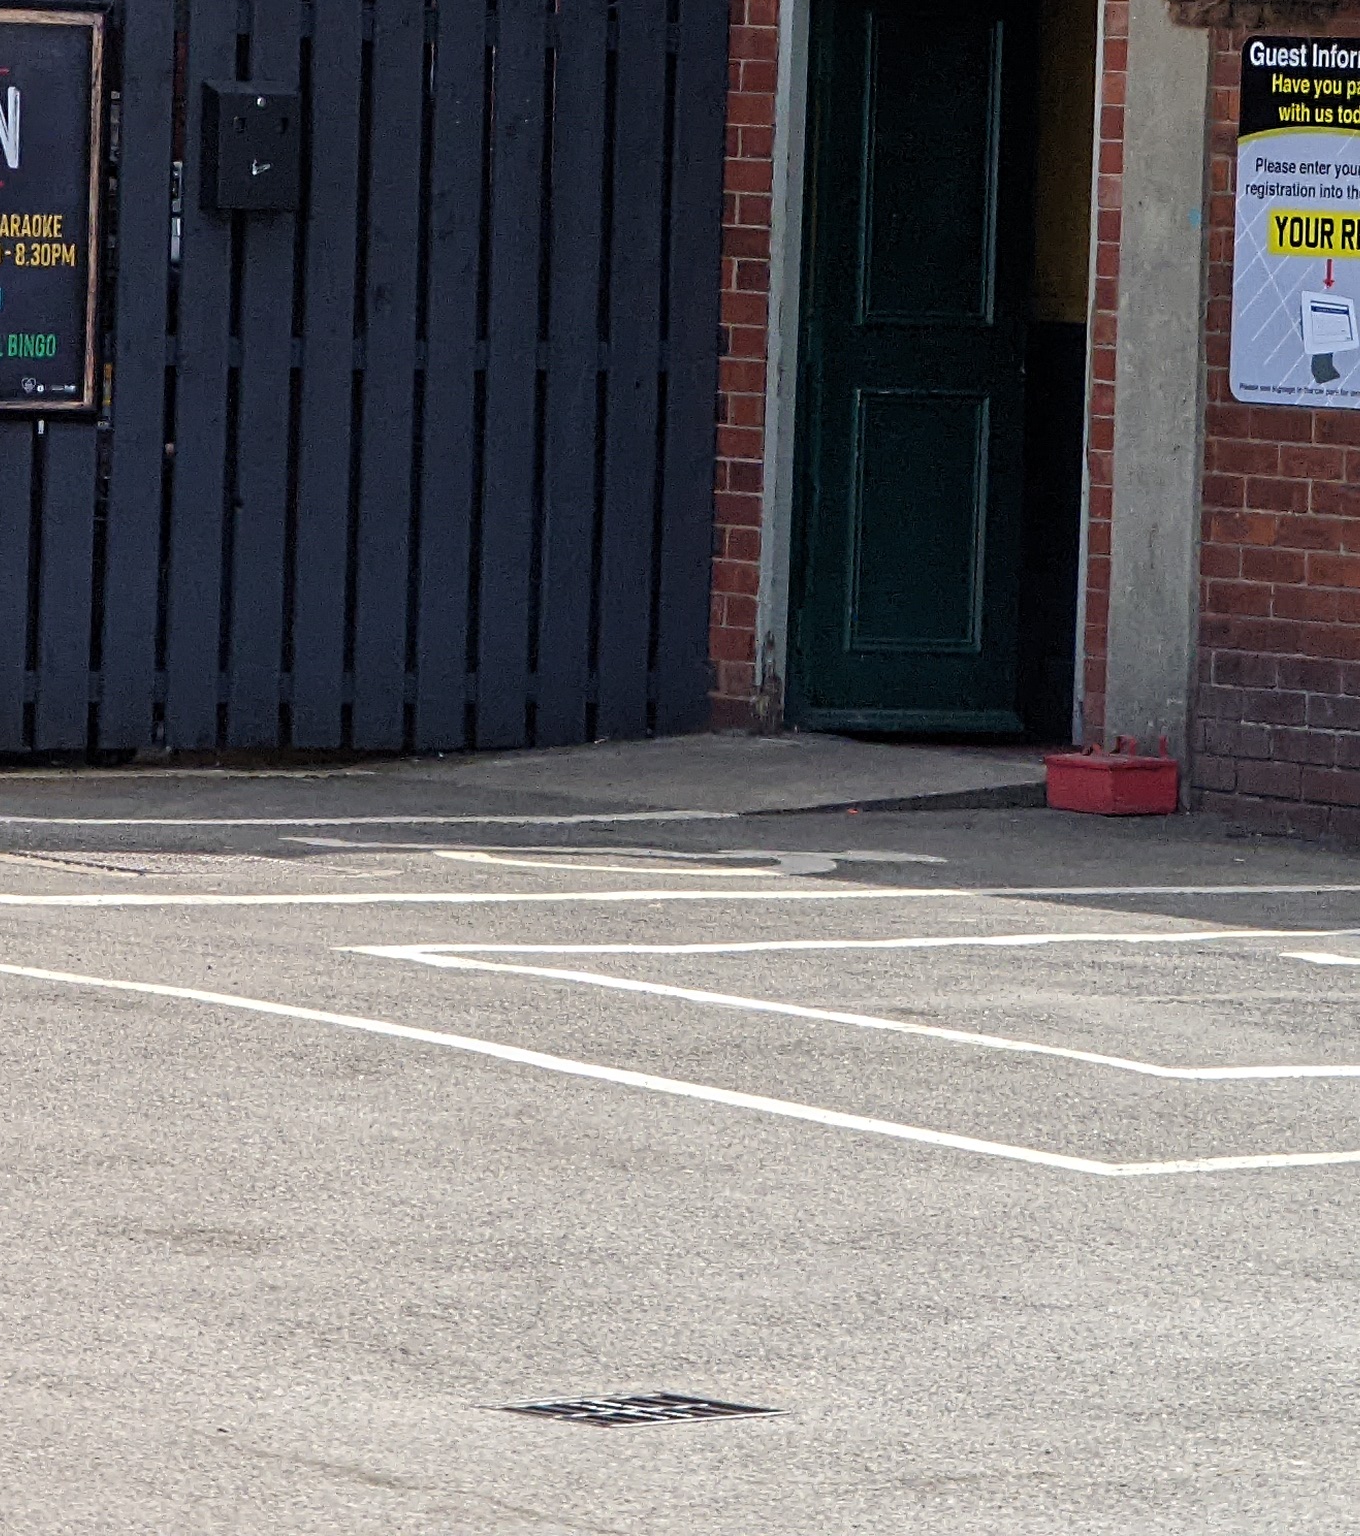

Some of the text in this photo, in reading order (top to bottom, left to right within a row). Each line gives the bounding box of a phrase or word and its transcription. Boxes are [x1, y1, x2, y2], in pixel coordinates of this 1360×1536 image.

[1249, 40, 1308, 68] Guest
[1271, 73, 1311, 95] Have
[1313, 79, 1342, 99] you
[1278, 103, 1311, 124] with
[1313, 108, 1334, 124] us
[1255, 157, 1297, 175] Please
[1299, 161, 1332, 176] enter
[1245, 182, 1316, 202] registration
[1319, 183, 1343, 200] into
[1274, 215, 1334, 250] YOUR
[15, 243, 76, 267] 8.30PM
[8, 334, 57, 358] BINGO
